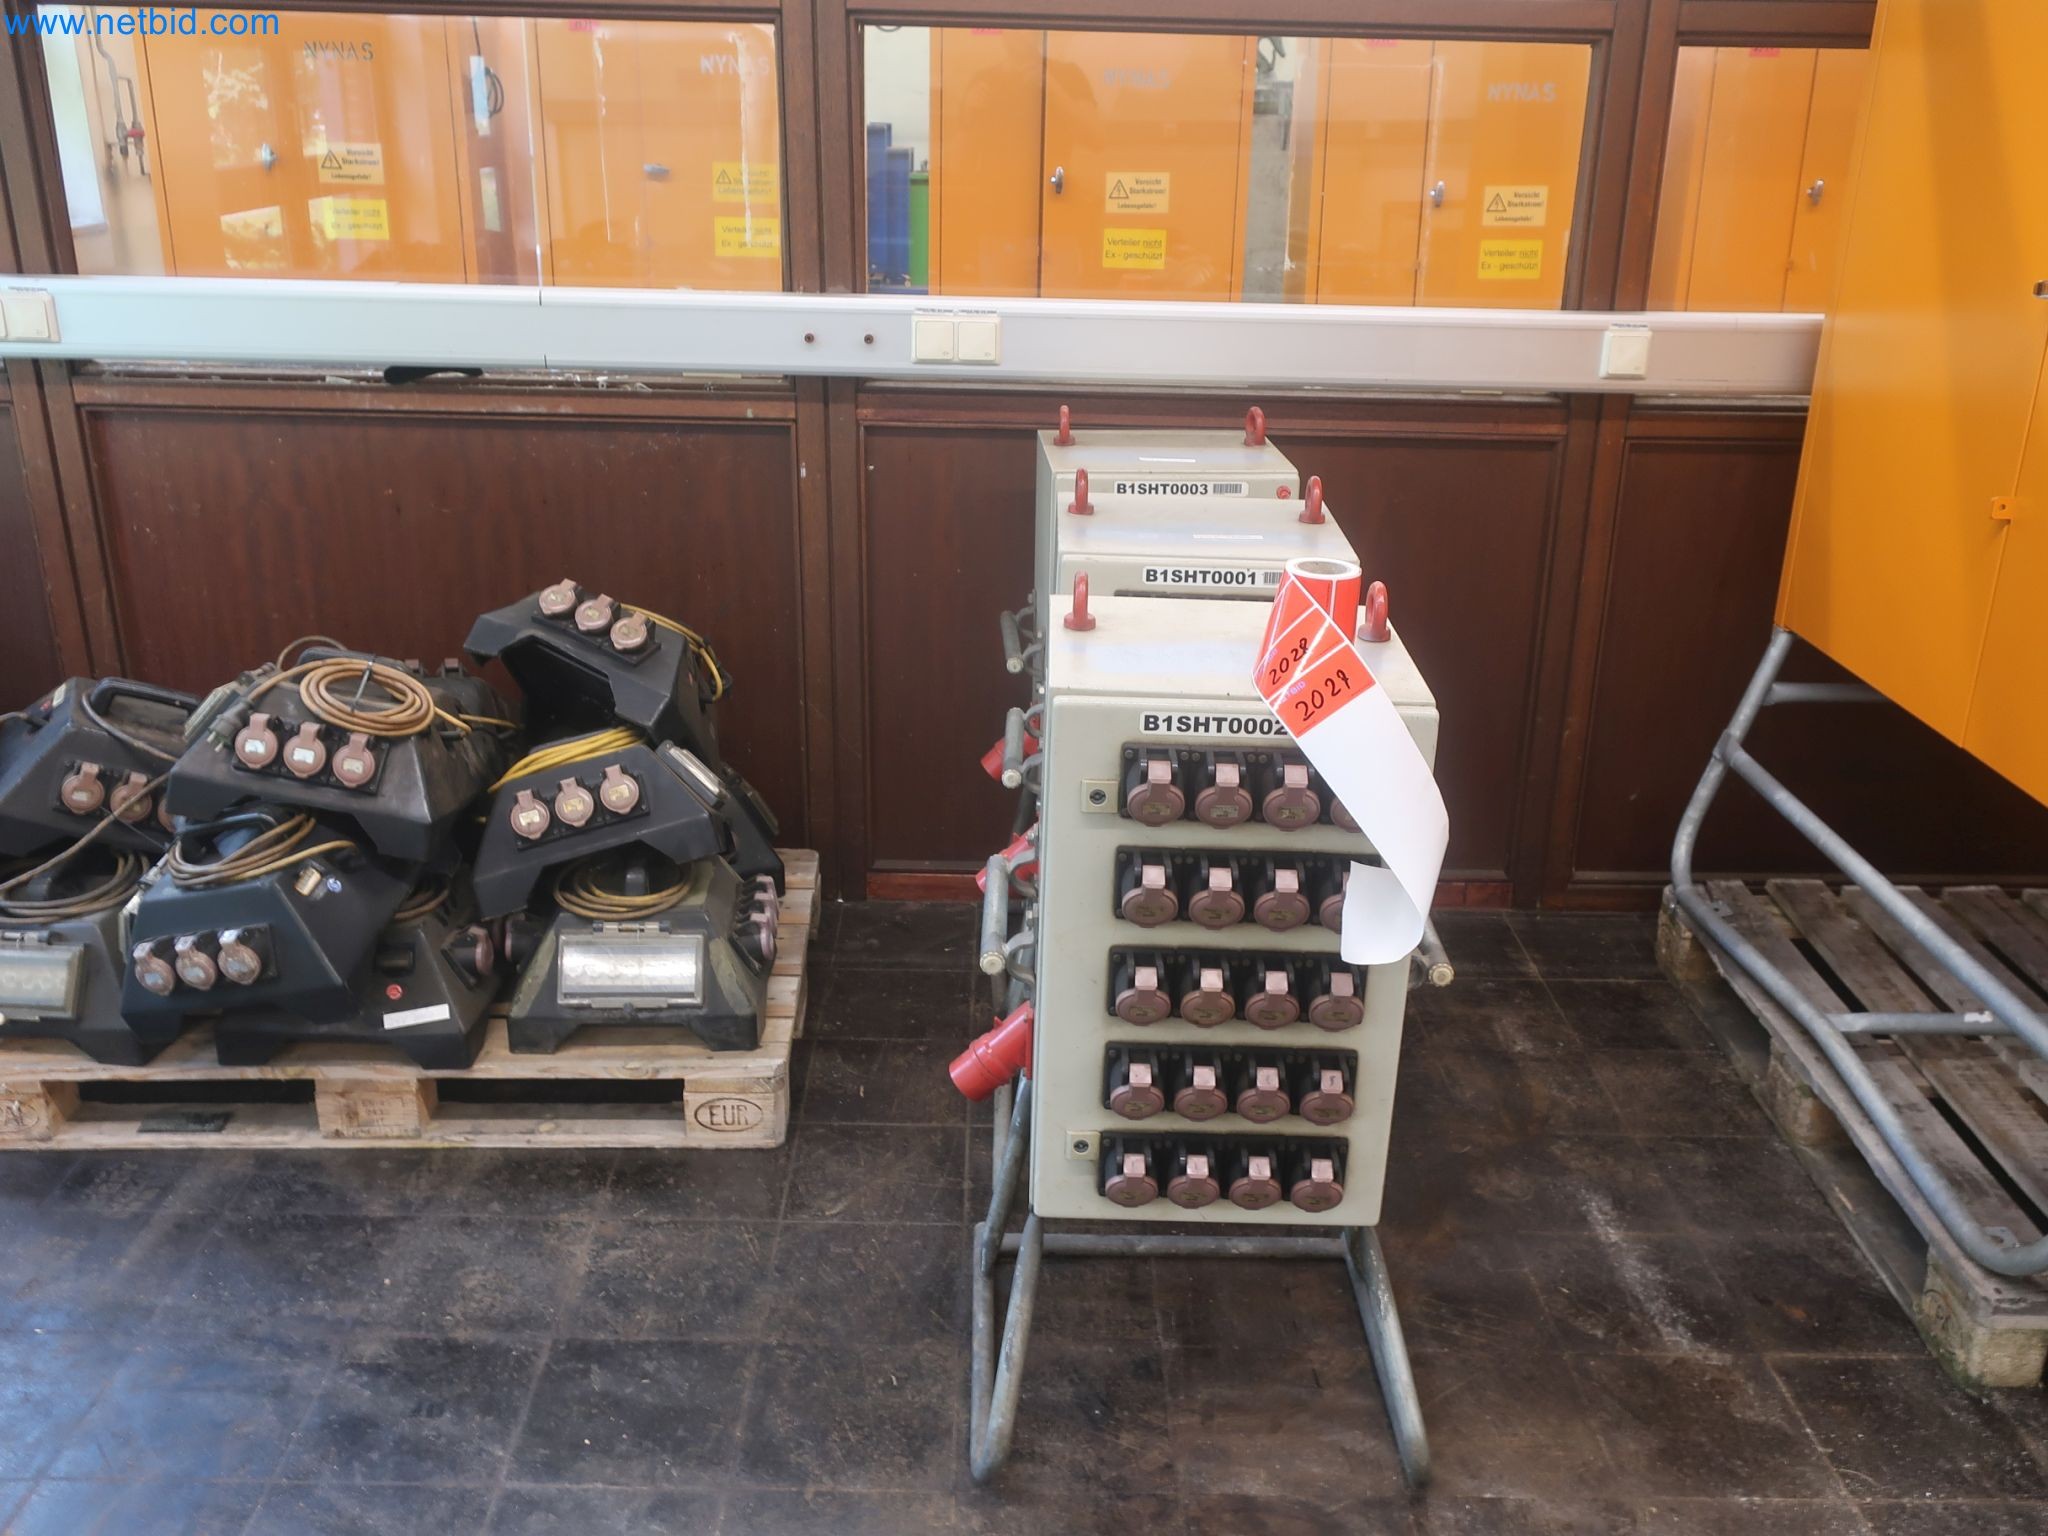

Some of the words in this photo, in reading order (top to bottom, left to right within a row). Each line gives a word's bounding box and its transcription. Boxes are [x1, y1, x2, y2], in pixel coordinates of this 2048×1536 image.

[304, 40, 374, 61] NYNAS
[1488, 83, 1558, 103] NYNAS
[1106, 237, 1140, 246] Verteiler
[1142, 239, 1163, 249] nicht
[1483, 248, 1517, 257] Verteiler
[1116, 483, 1209, 496] B1SHT0003
[1145, 568, 1257, 586] B1SHT0001
[707, 1104, 749, 1126] EUR
